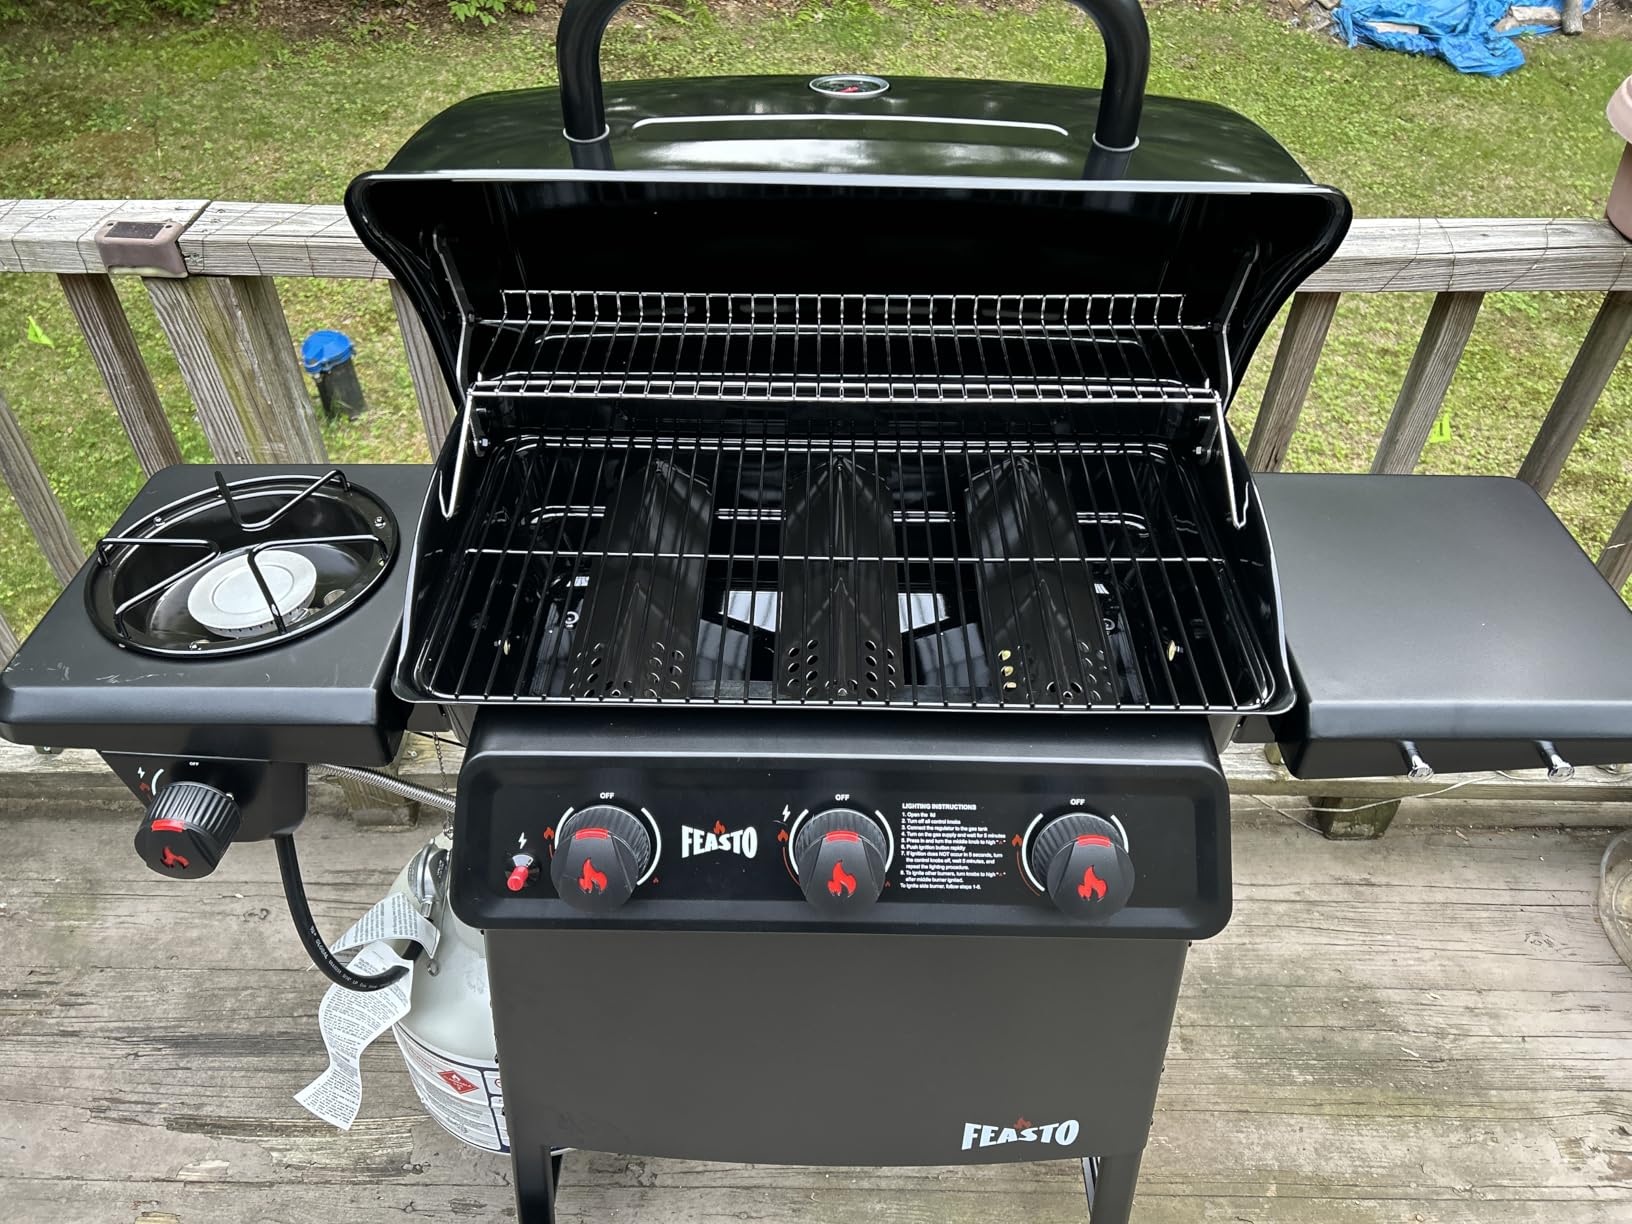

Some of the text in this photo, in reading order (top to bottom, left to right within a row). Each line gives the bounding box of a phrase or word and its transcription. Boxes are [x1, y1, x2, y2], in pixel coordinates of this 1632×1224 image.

[599, 791, 615, 799] OFF
[834, 793, 850, 801] OFF
[681, 825, 758, 859] FEASTO
[961, 1119, 1080, 1150] FEASTO
